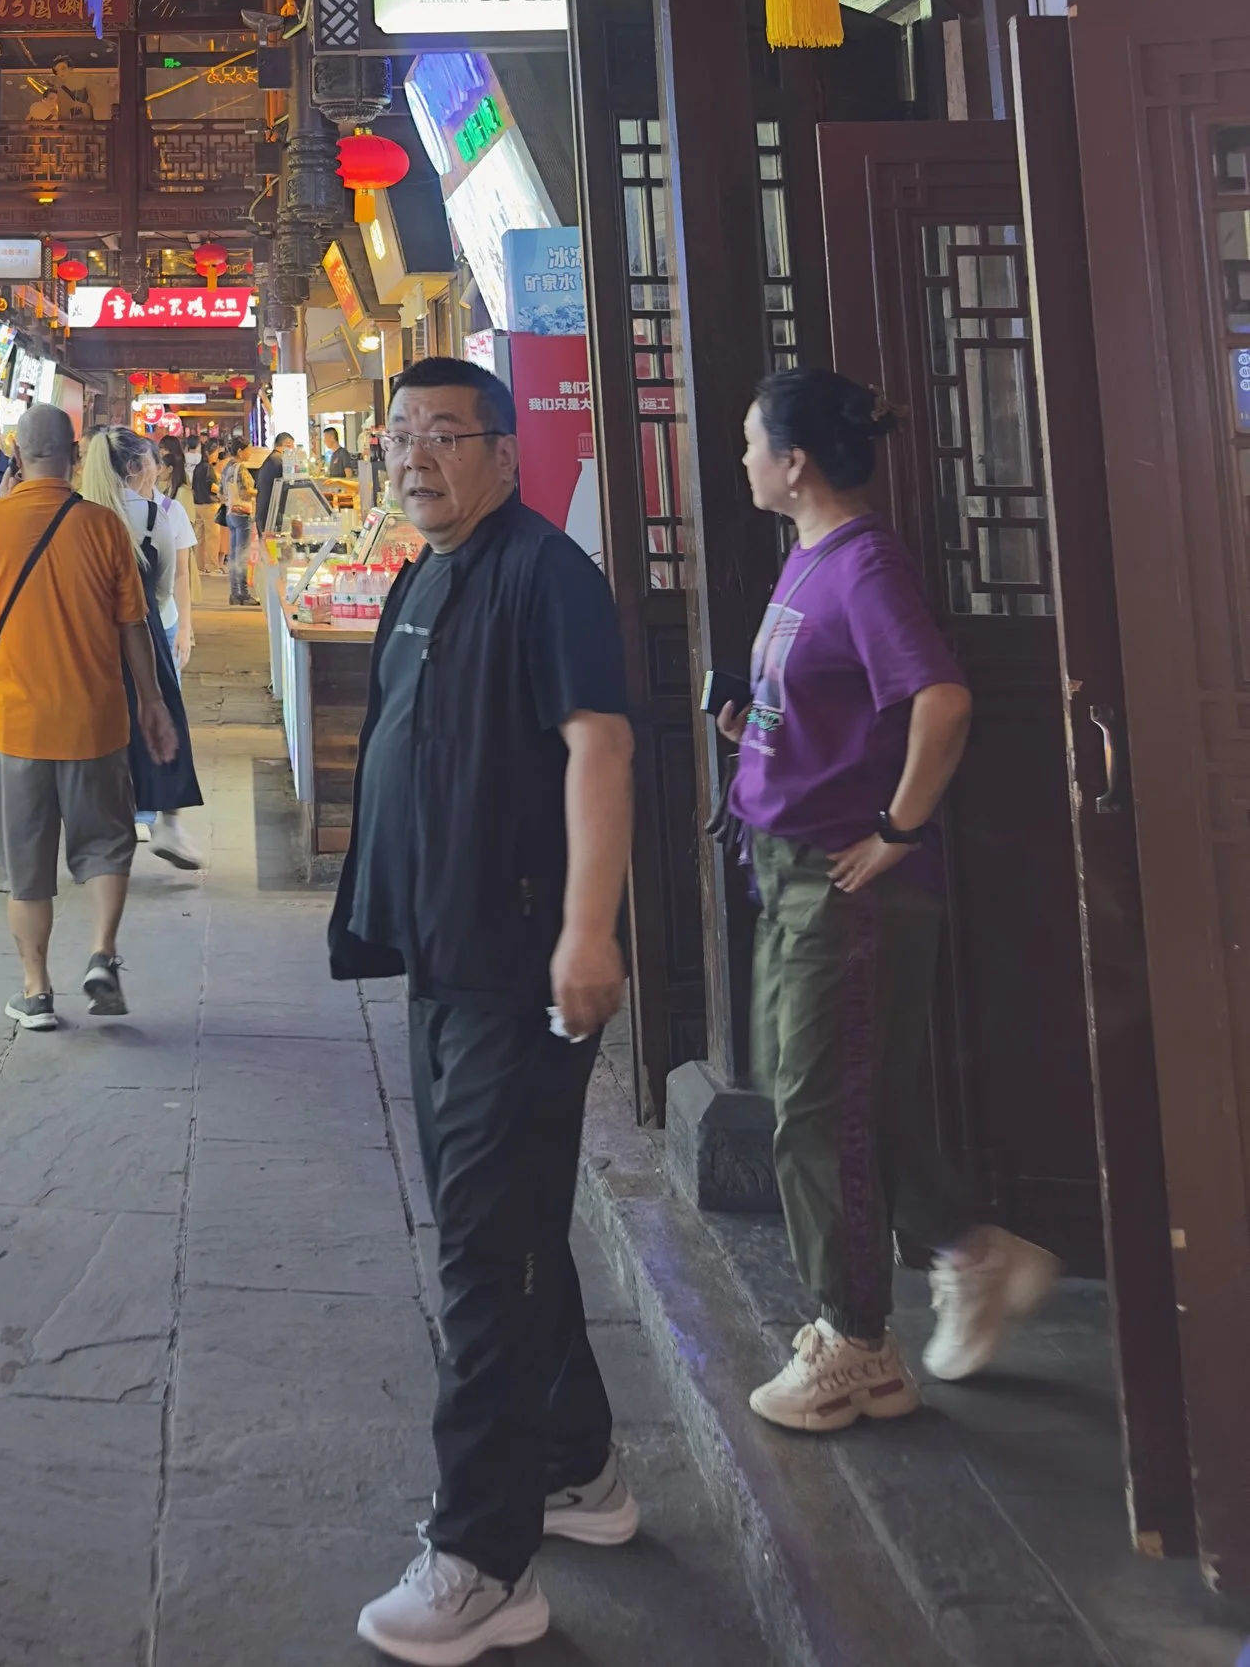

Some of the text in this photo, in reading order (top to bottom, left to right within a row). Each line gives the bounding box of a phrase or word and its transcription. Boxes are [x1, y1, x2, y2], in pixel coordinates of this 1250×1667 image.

[524, 273, 575, 292] 矿泉水
[528, 398, 591, 411] 我们只是大
